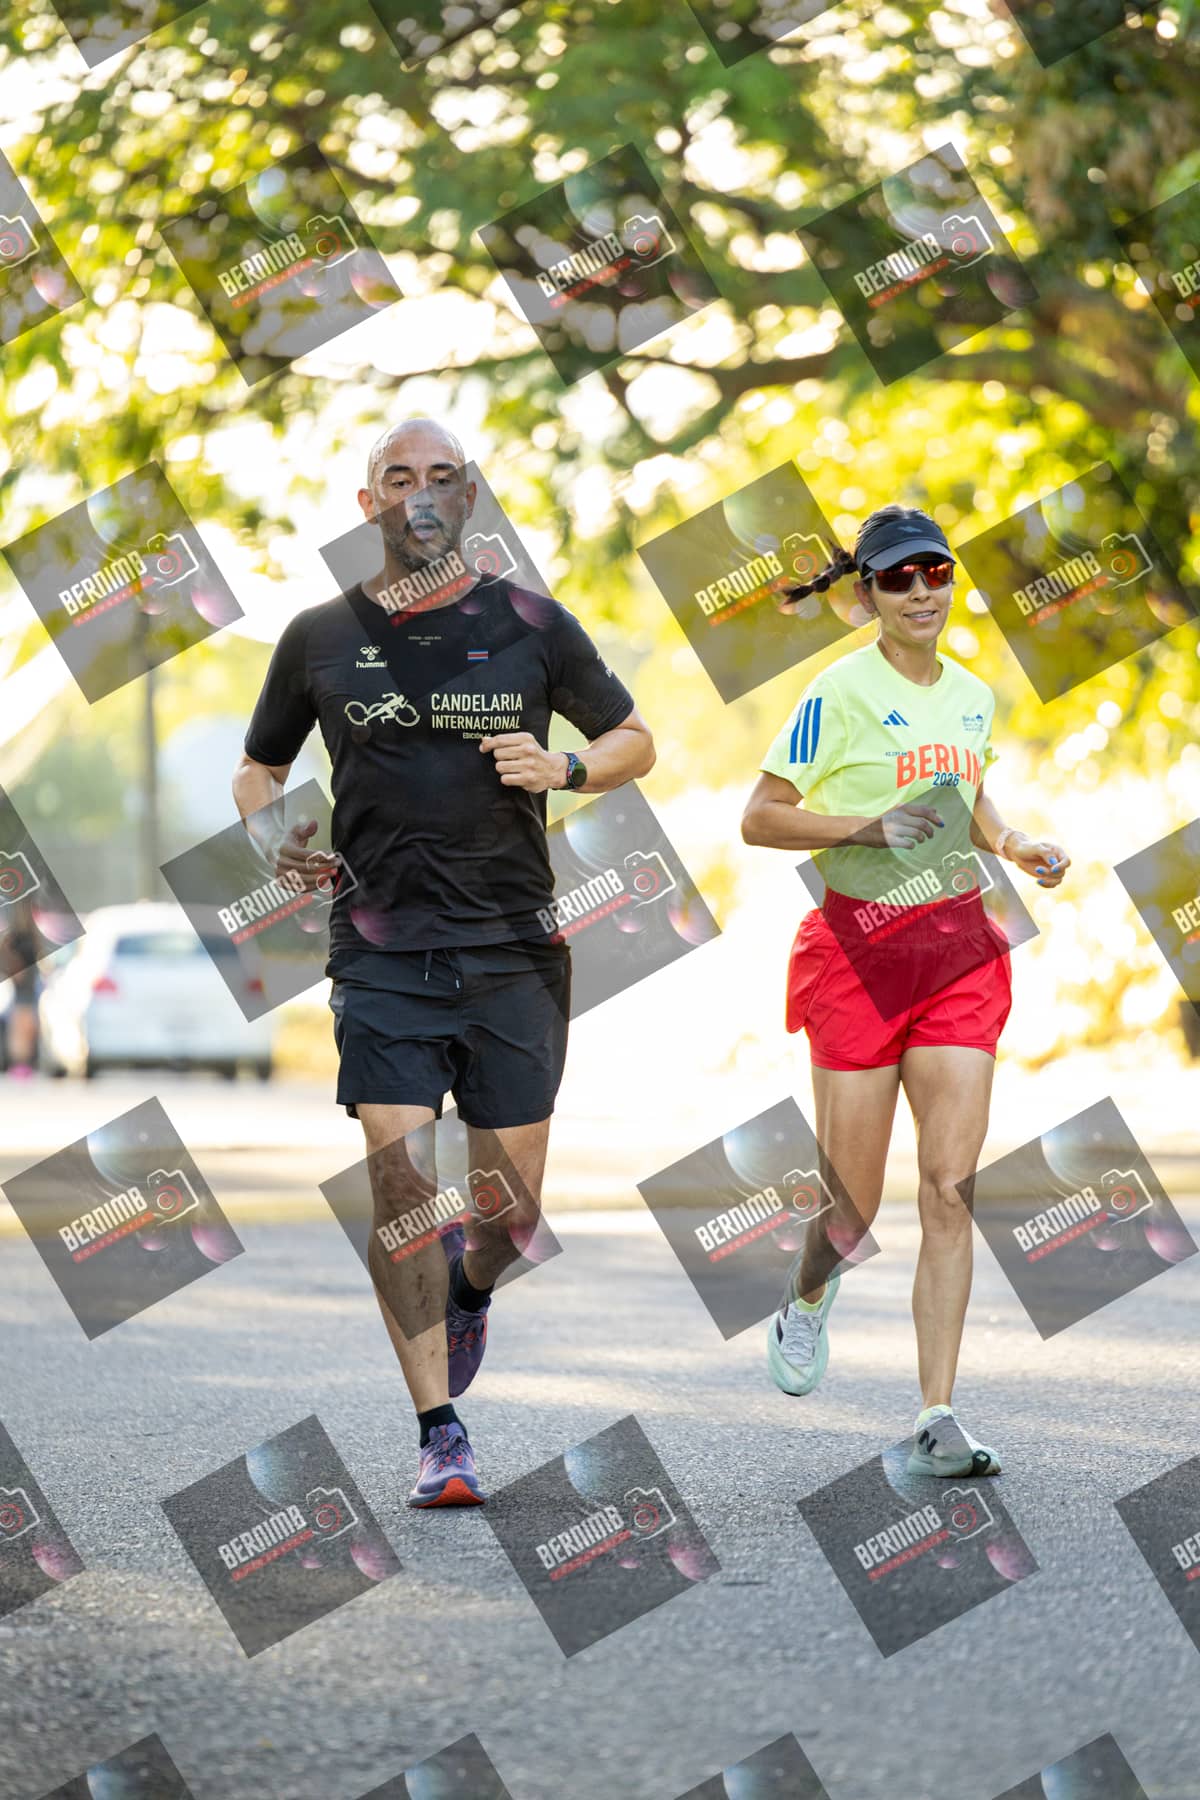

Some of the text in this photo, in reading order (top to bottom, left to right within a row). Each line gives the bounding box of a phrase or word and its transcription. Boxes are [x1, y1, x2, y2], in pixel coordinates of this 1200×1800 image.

[431, 693, 523, 712] CANDELARIA
[432, 714, 521, 730] INTERNACIONAL
[932, 771, 960, 787] 2026
